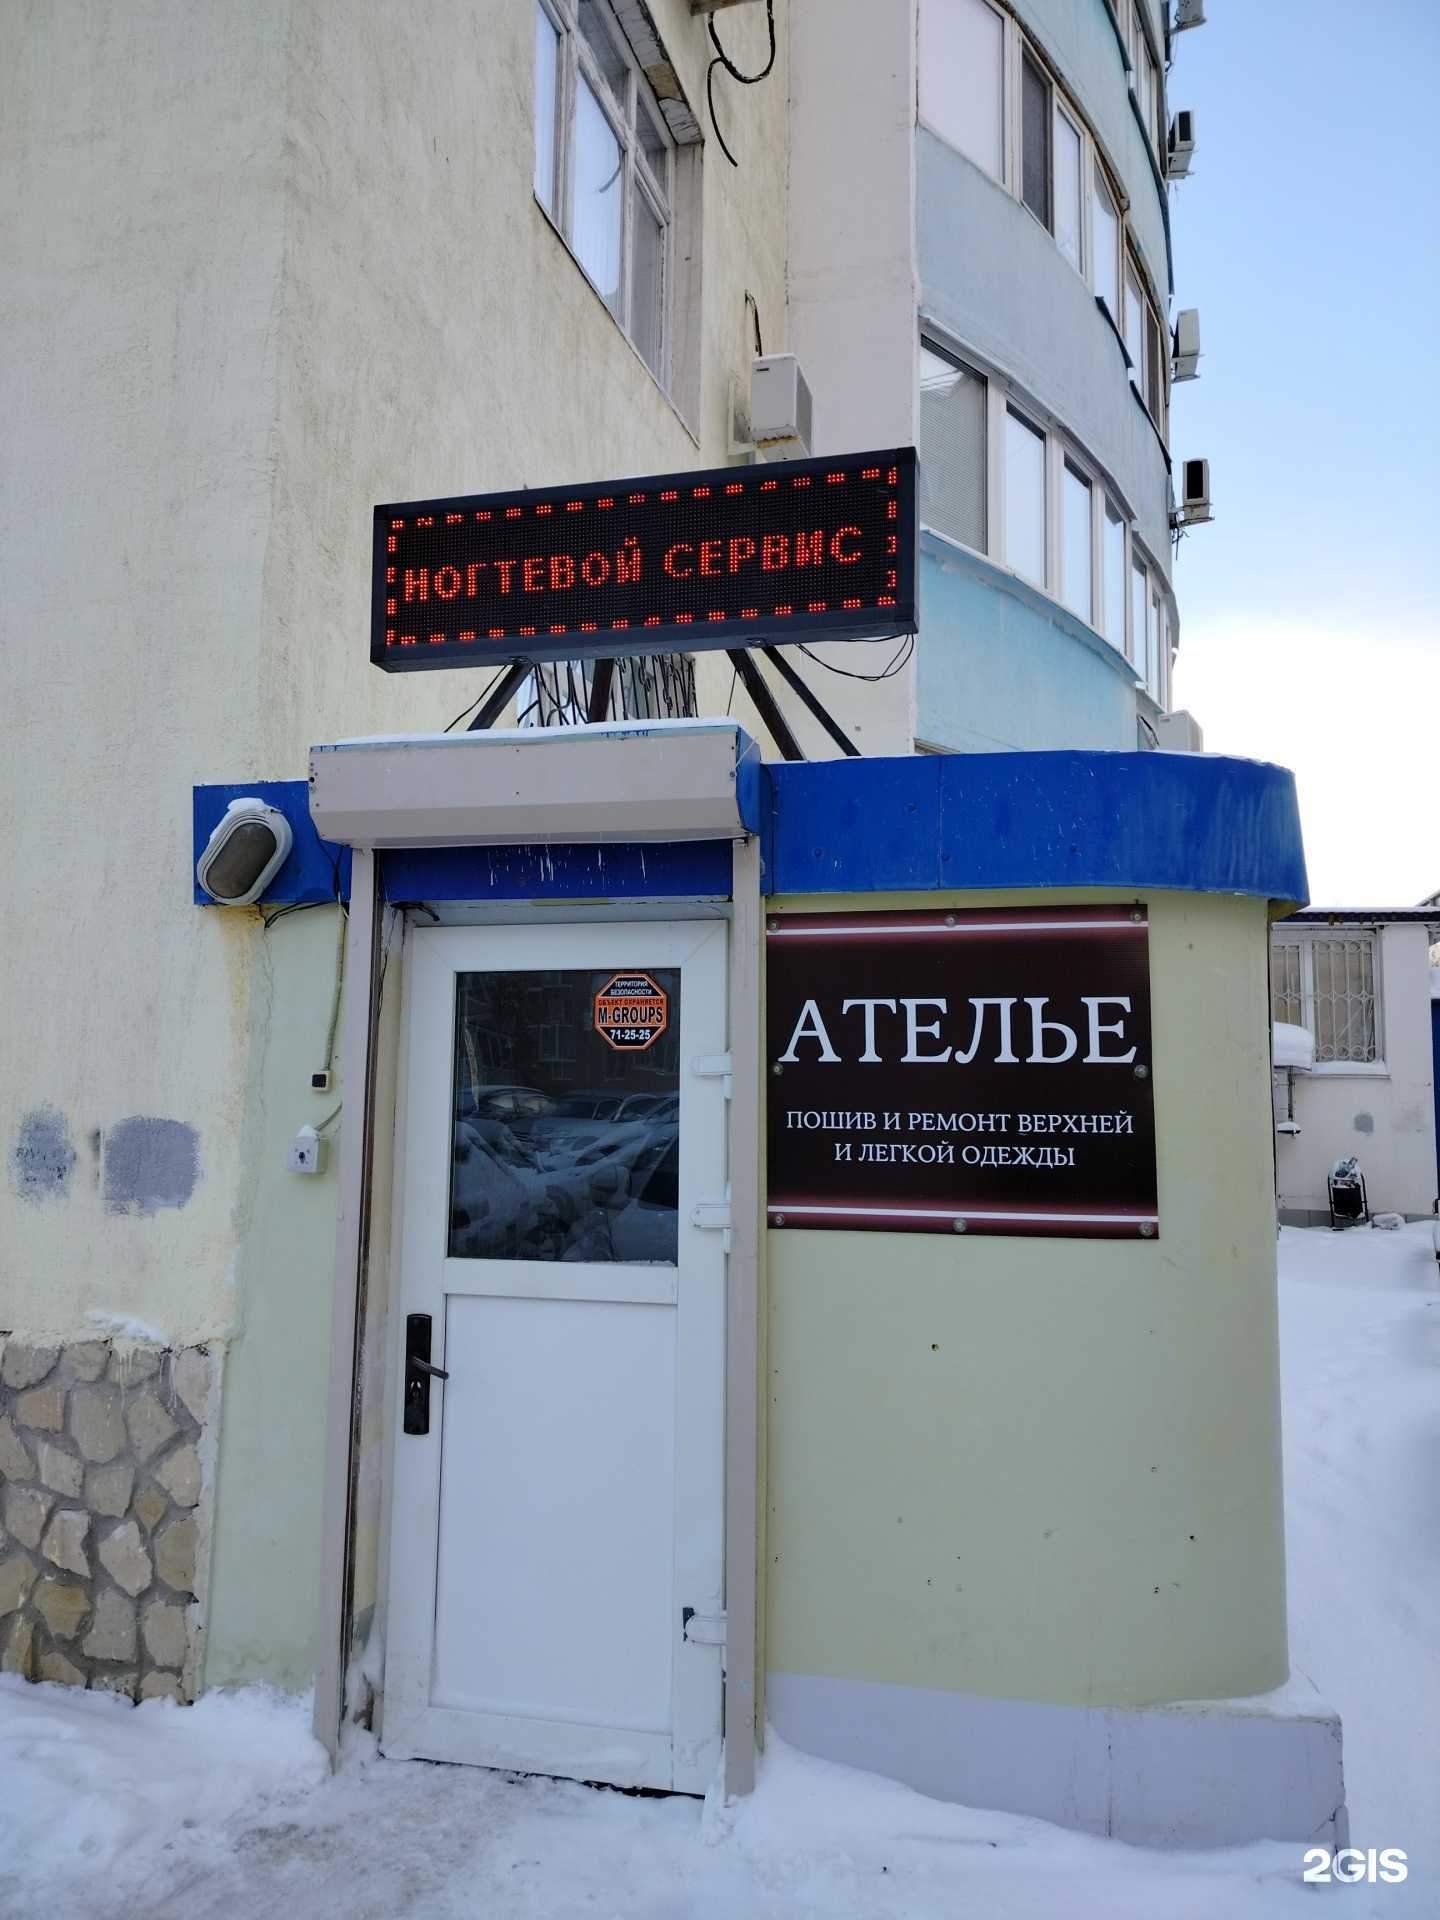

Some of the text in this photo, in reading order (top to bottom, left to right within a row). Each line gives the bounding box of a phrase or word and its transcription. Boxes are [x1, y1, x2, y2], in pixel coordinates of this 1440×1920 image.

[404, 526, 863, 602] НОГТЕВОЙ СЕРВИС
[610, 988, 652, 996] БЕЗОПАСНОСТИ
[615, 980, 648, 988] ТЕРРИТОРИЯ
[598, 1006, 663, 1024] M-GROUPS
[610, 1029, 651, 1040] 71-25-25
[777, 996, 1138, 1064] АТЕЛЬЕ
[786, 1110, 1134, 1134] ПОШИВ И РЕМОНТ ВЕРХНЕЙ
[834, 1140, 1076, 1168] И ЛЕГКОЙ ОДЕЖДЫ
